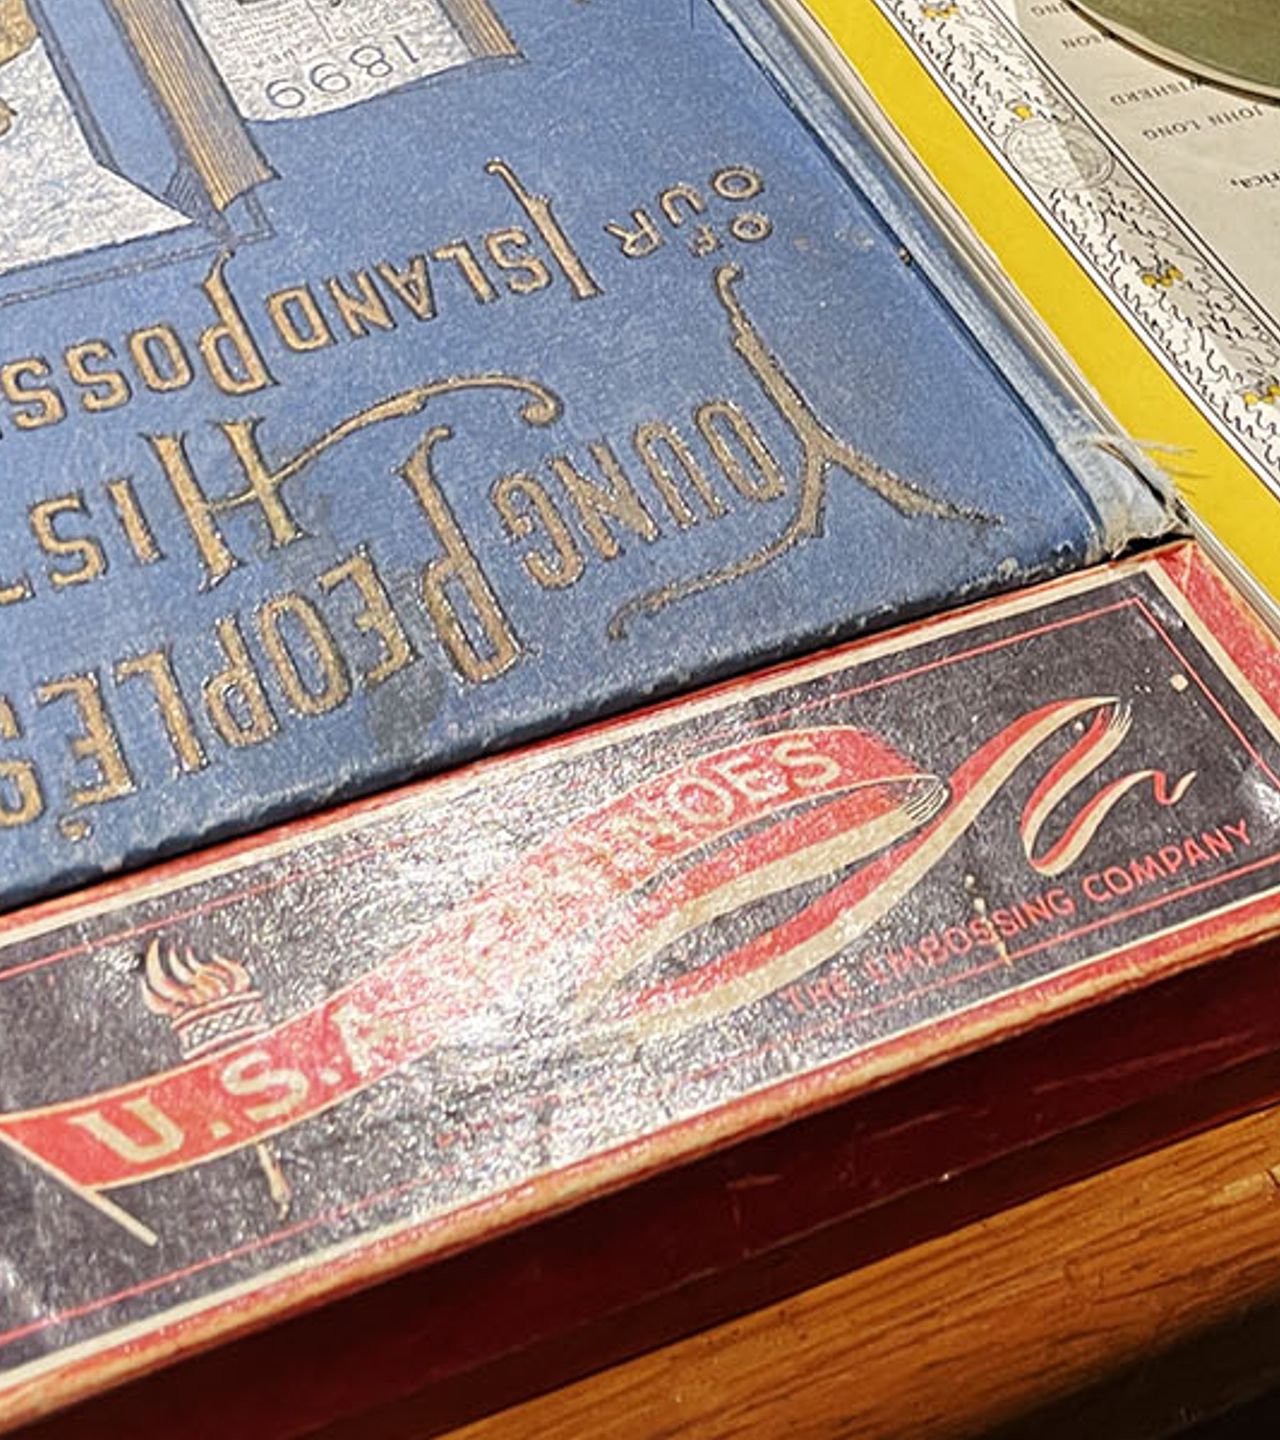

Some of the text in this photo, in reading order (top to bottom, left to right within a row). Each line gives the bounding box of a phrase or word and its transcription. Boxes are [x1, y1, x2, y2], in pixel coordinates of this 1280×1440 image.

[266, 34, 420, 110] 1899
[1141, 119, 1201, 142] LONG
[1207, 105, 1264, 127] JOHN
[603, 164, 767, 260] OUR
[688, 210, 772, 257] OF
[267, 158, 603, 354] ISLAND
[491, 263, 1007, 642] YOUNG
[777, 818, 1254, 1014] THE EMBOSSING COMPANY
